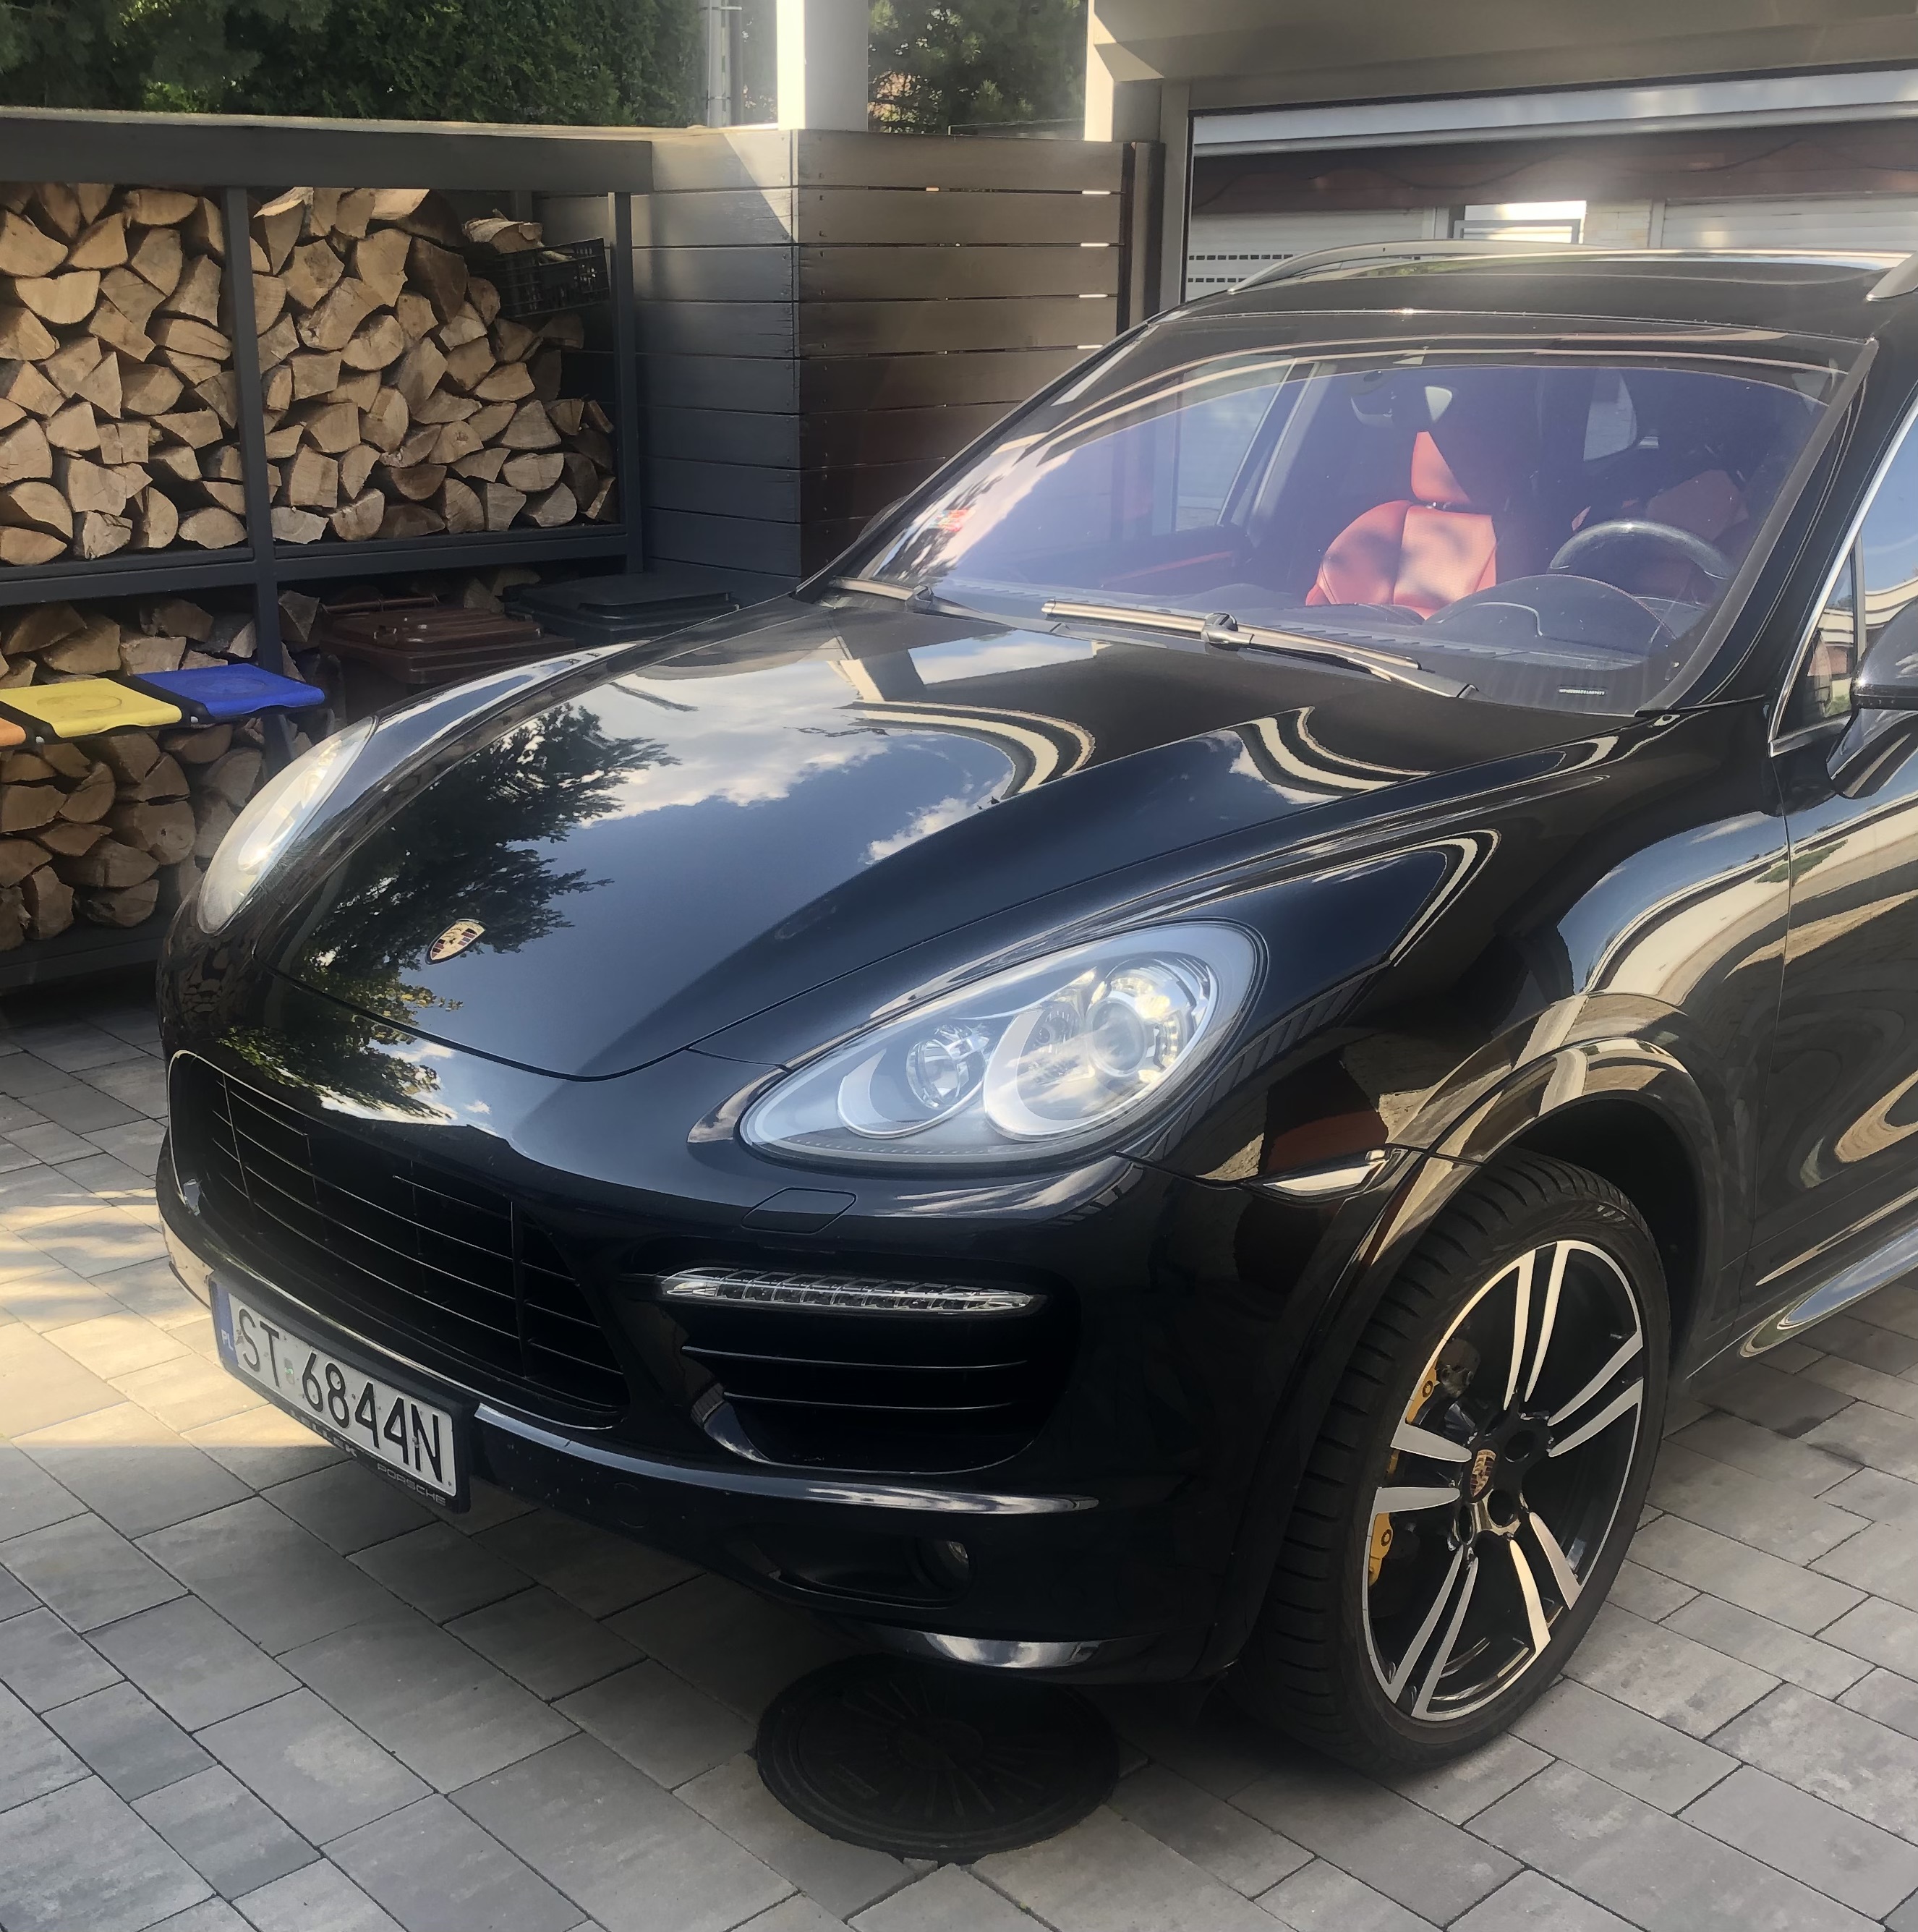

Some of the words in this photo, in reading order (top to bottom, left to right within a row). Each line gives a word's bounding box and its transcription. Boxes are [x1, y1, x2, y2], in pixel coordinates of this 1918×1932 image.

[221, 1329, 234, 1351] PL
[239, 1308, 280, 1388] ST
[302, 1353, 443, 1484] 6844N
[377, 1463, 446, 1507] PORSCHE
